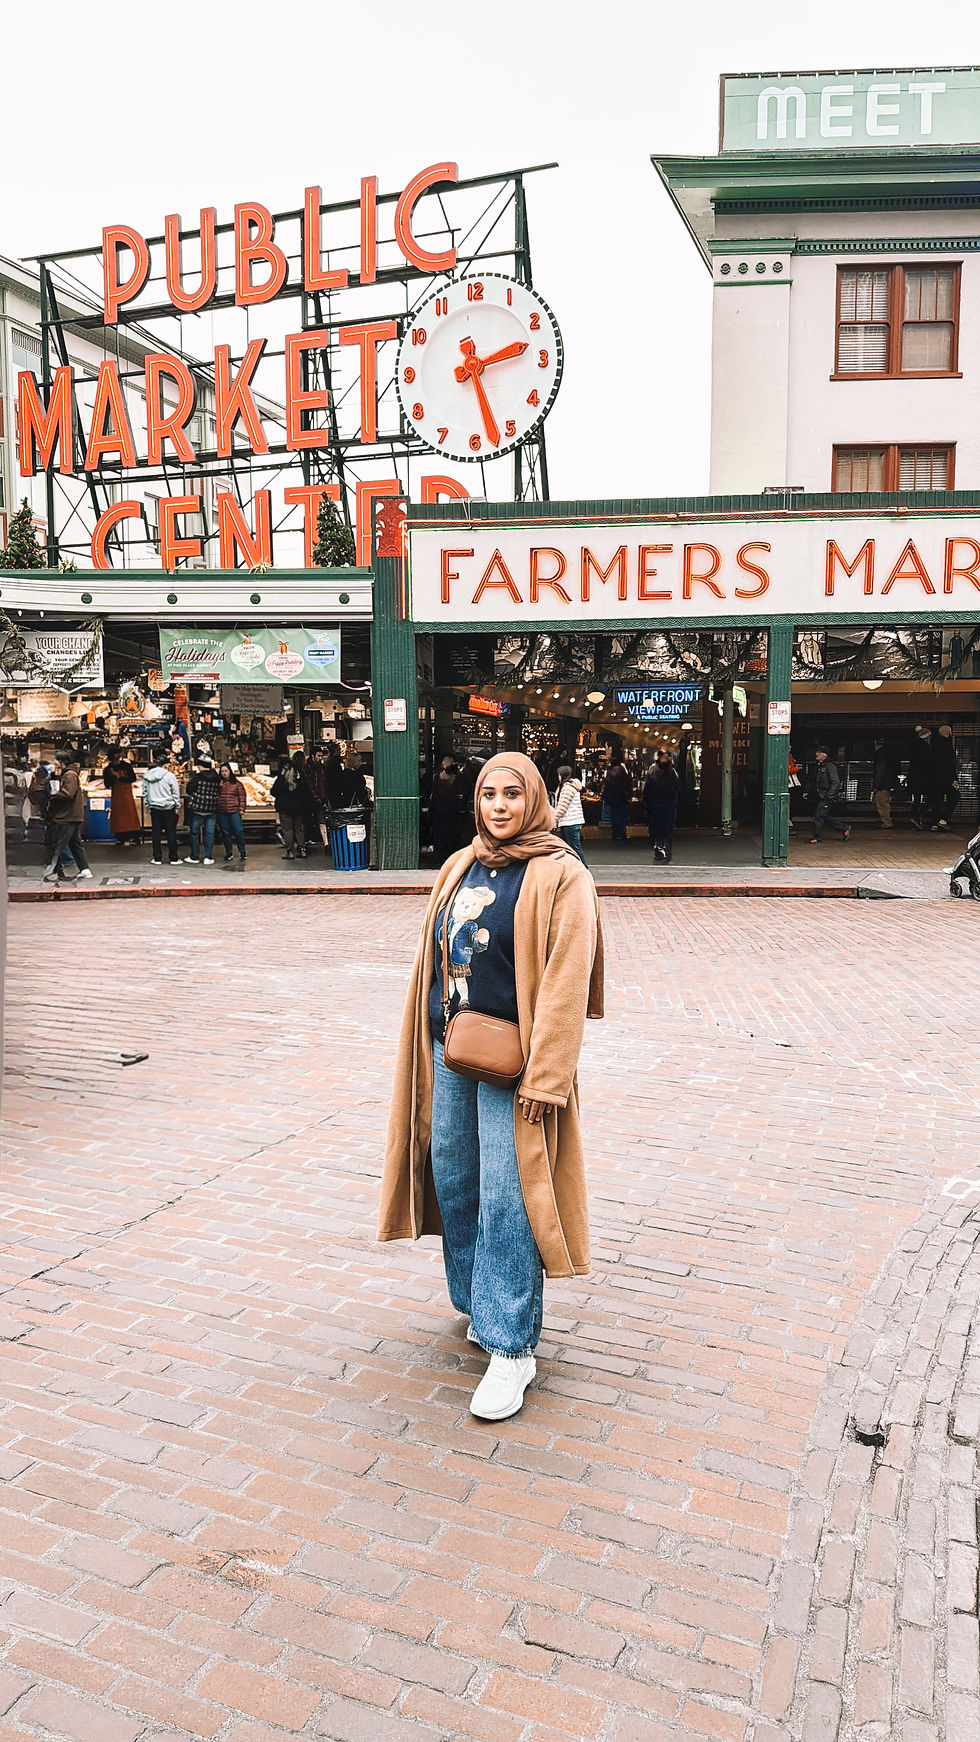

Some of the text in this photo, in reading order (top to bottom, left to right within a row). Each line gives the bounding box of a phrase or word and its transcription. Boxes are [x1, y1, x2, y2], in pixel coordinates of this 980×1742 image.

[757, 82, 946, 139] MEET
[102, 161, 459, 324] PUBLIC
[467, 281, 485, 301] 12
[507, 287, 512, 306] 1
[435, 297, 448, 316] 11
[529, 312, 540, 330] 2
[412, 328, 427, 346] 10
[537, 349, 549, 368] 3
[403, 366, 416, 384] 9
[18, 320, 399, 477] MARKET
[526, 388, 540, 408] 4
[412, 402, 424, 420] 8
[437, 427, 449, 444] 7
[504, 419, 517, 437] 5
[469, 433, 482, 451] 6
[440, 541, 771, 604] FARMERS
[35, 637, 62, 649] YOUR
[173, 638, 224, 647] CELEBRATE THE
[165, 647, 226, 668] Holidays
[617, 689, 701, 703] WATERFRONT
[628, 704, 690, 715] VIEWPOINT
